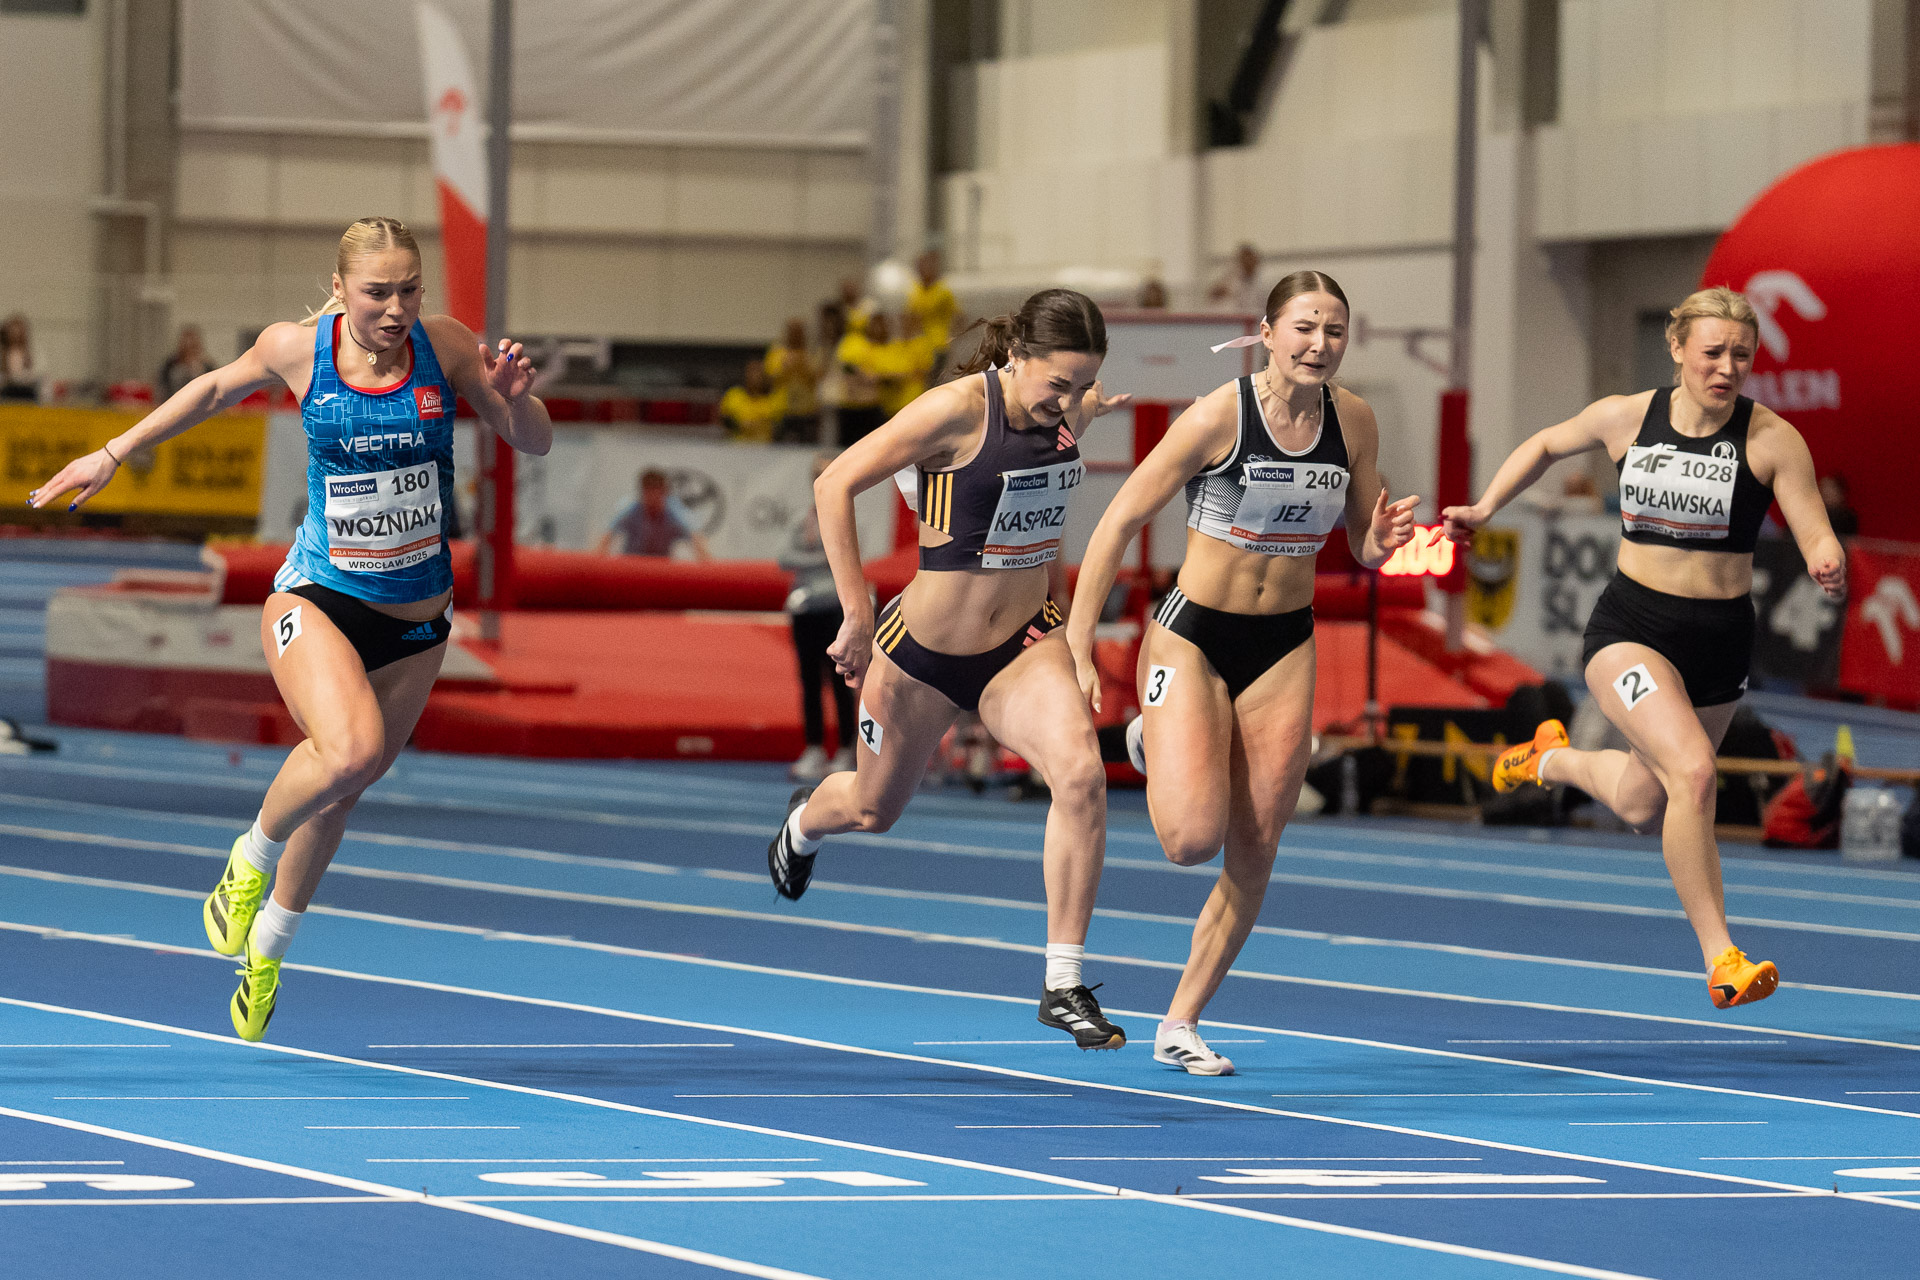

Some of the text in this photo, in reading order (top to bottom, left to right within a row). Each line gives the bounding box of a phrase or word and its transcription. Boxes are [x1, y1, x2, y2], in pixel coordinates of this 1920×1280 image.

[339, 431, 426, 453] VECTRA
[1252, 468, 1292, 480] Wrocław
[1631, 453, 1675, 474] 4F
[1680, 460, 1733, 483] 1028
[331, 482, 375, 494] Wrocław
[391, 470, 430, 495] 180
[1011, 476, 1047, 488] Wrocław
[1305, 470, 1343, 490] 240
[1272, 500, 1313, 523] JEŻ
[1625, 484, 1725, 517] PUŁAWSKA
[331, 503, 437, 537] WOŹNIAK
[1244, 542, 1316, 554] WROCŁAW 2025
[349, 551, 428, 569] WROCŁAW 2025
[1002, 553, 1044, 566] WROCŁAW
[280, 611, 294, 647] 5
[401, 632, 438, 641] adidas
[1149, 669, 1166, 703] 3
[1622, 671, 1649, 703] 2
[860, 718, 875, 745] 4
